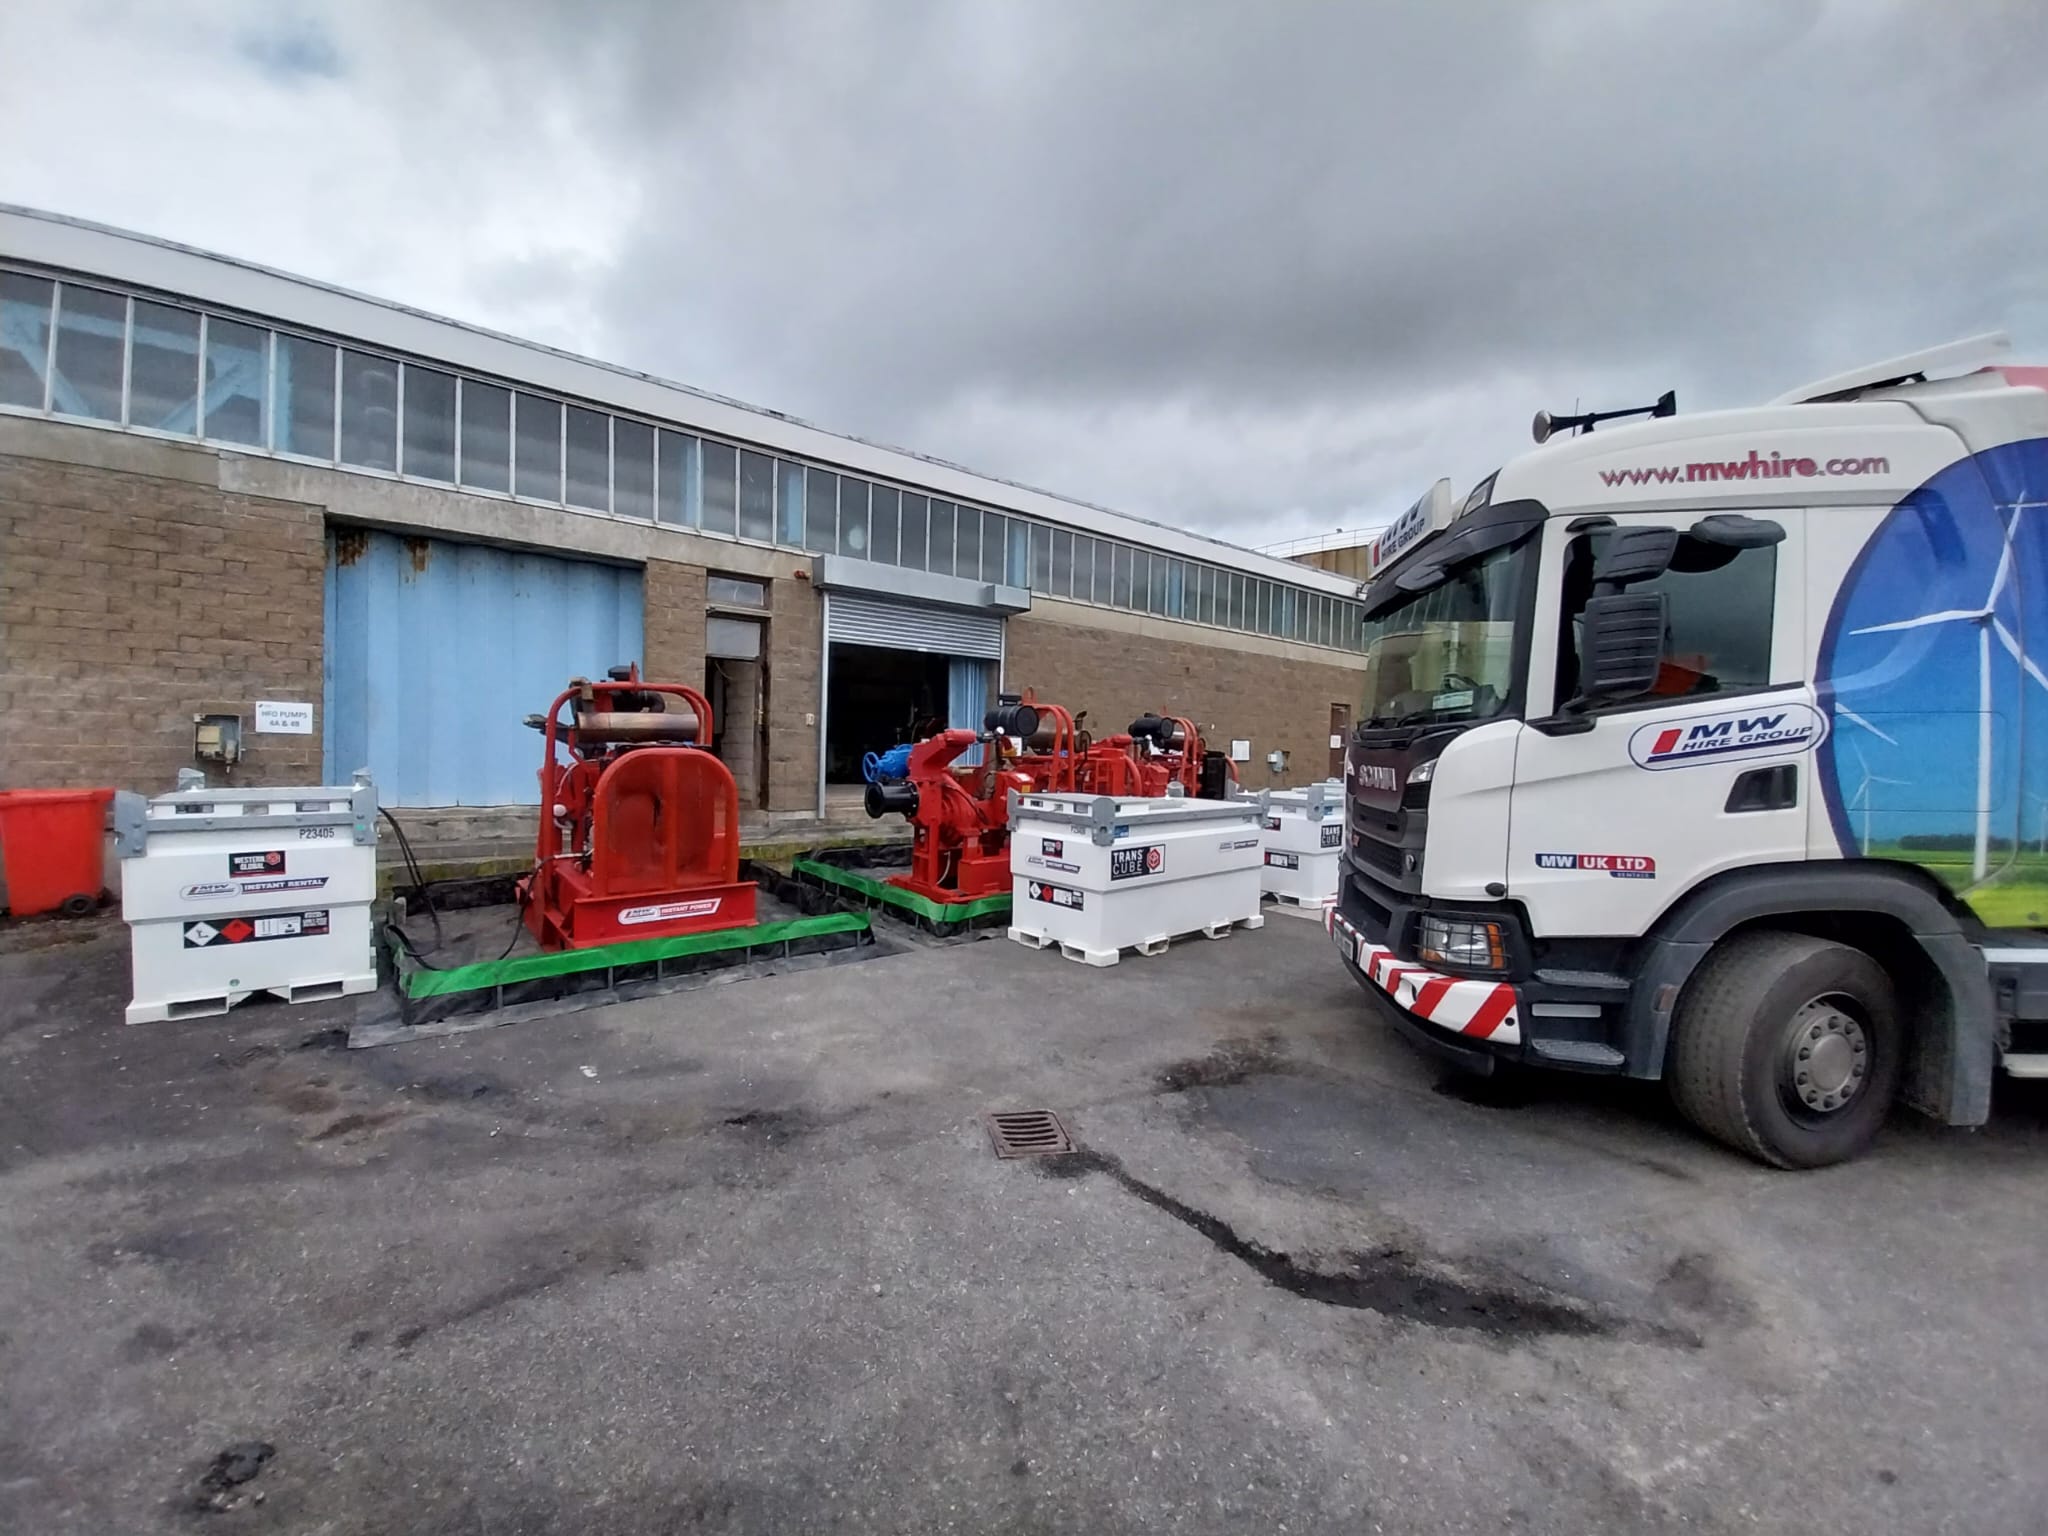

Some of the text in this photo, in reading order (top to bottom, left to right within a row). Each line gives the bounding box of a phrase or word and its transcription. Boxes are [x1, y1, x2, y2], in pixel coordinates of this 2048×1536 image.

[1599, 450, 1890, 487] www.mwhire.com
[1398, 518, 1425, 548] GROUP
[1688, 713, 1787, 740] MW
[1681, 726, 1813, 752] HIRE GROUP
[299, 827, 335, 839] P23405
[1322, 827, 1341, 836] TRANS
[1113, 850, 1143, 863] TRANS
[1541, 855, 1647, 870] MW UK LTD
[1112, 861, 1143, 875] CUBE
[244, 882, 285, 891] INSTANT
[287, 879, 324, 888] RENTAL
[661, 905, 689, 913] INSTANT
[689, 902, 713, 910] POWER
